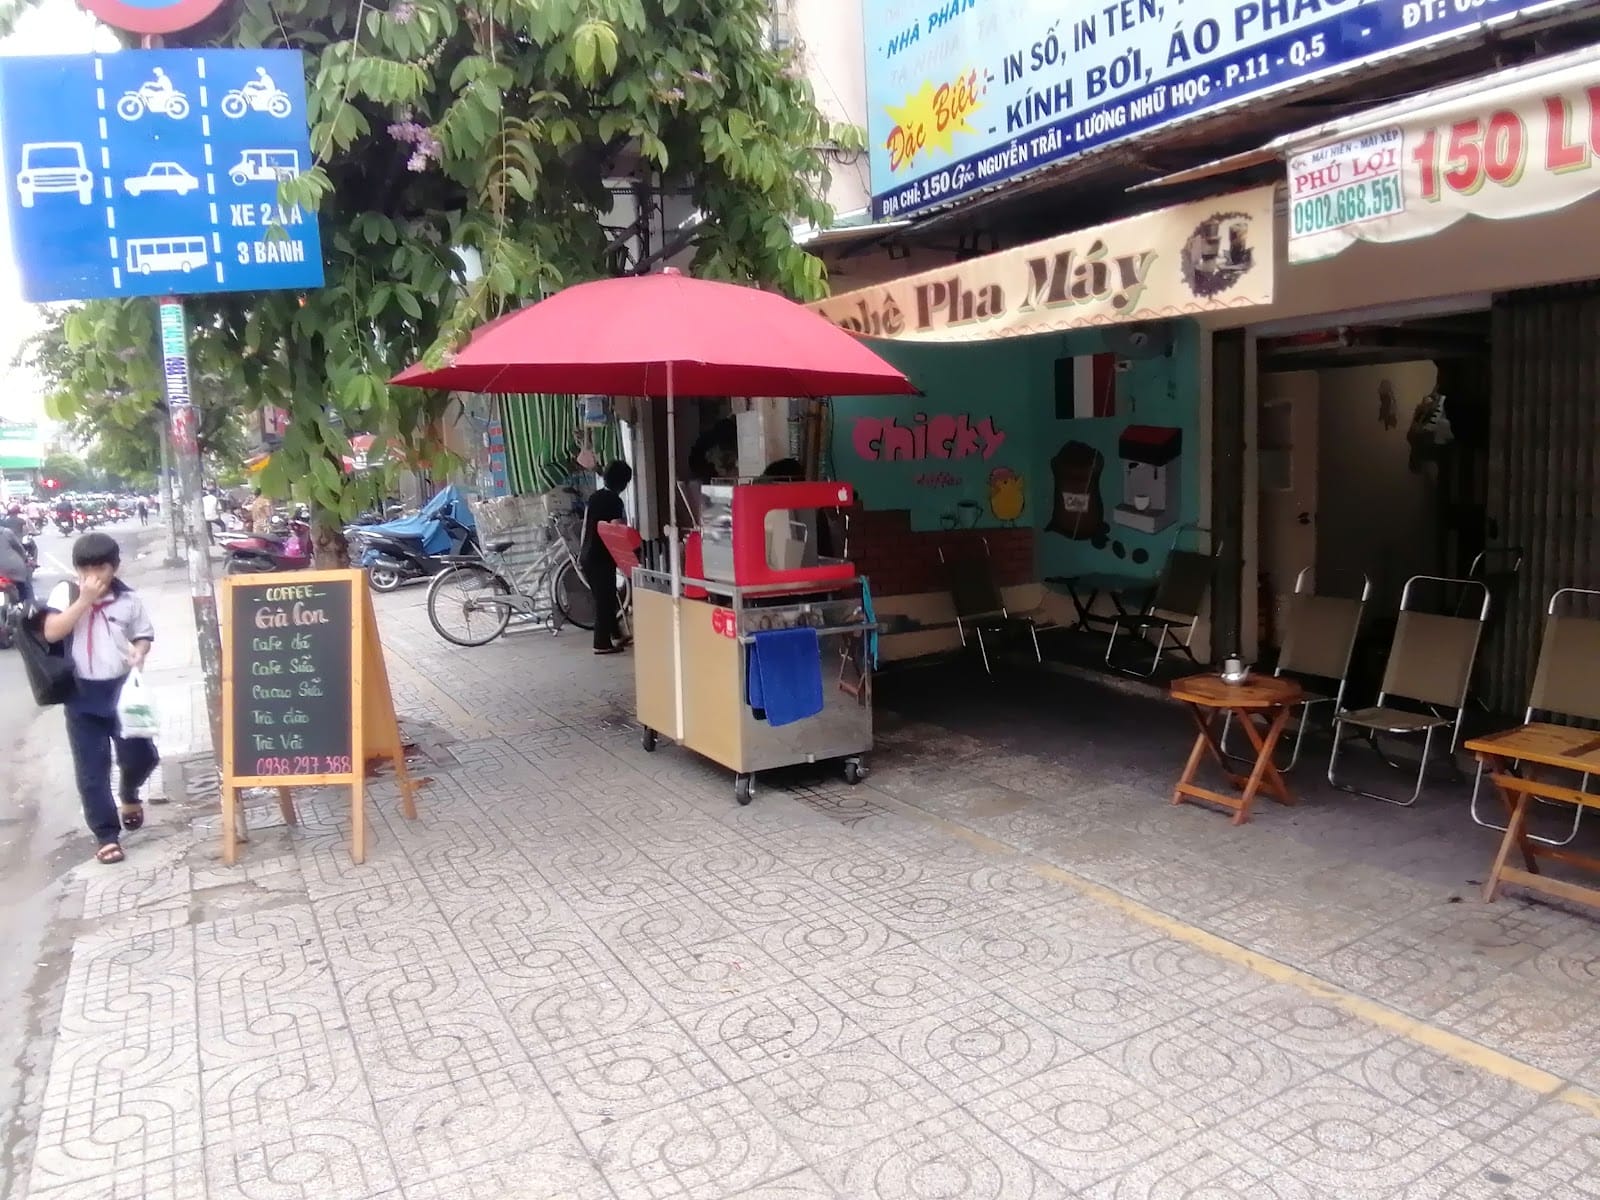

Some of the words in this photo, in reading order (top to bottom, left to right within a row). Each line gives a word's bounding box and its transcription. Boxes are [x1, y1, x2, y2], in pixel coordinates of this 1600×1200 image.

[1003, 50, 1023, 85] IN
[1030, 19, 1067, 72] SỐ,
[1073, 15, 1097, 53] IN
[1006, 78, 1074, 134] KÍNH
[1086, 46, 1153, 100] BƠI,
[1166, 18, 1221, 68] ÁO
[922, 171, 950, 201] 150
[977, 139, 1029, 179] NGUYỄN
[1030, 127, 1062, 158] TRÃI
[1076, 103, 1126, 142] LƯƠNG
[1171, 75, 1211, 107] HỌC
[1226, 53, 1270, 88] P.11
[1290, 33, 1326, 67] Q.5
[886, 120, 927, 173] Đặc
[1294, 160, 1342, 194] PHÚ
[1351, 148, 1397, 177] LỢI
[1413, 108, 1528, 203] 150
[230, 203, 256, 227] XE
[260, 202, 273, 226] 2
[237, 241, 250, 265] 3
[914, 276, 1007, 334] Pha
[1018, 236, 1159, 315] Máy
[255, 606, 289, 629] Gà
[293, 601, 329, 626] Con
[266, 585, 313, 602] COFFEE
[257, 756, 290, 776] 0938
[293, 755, 320, 775] 297
[325, 755, 351, 775] 388
